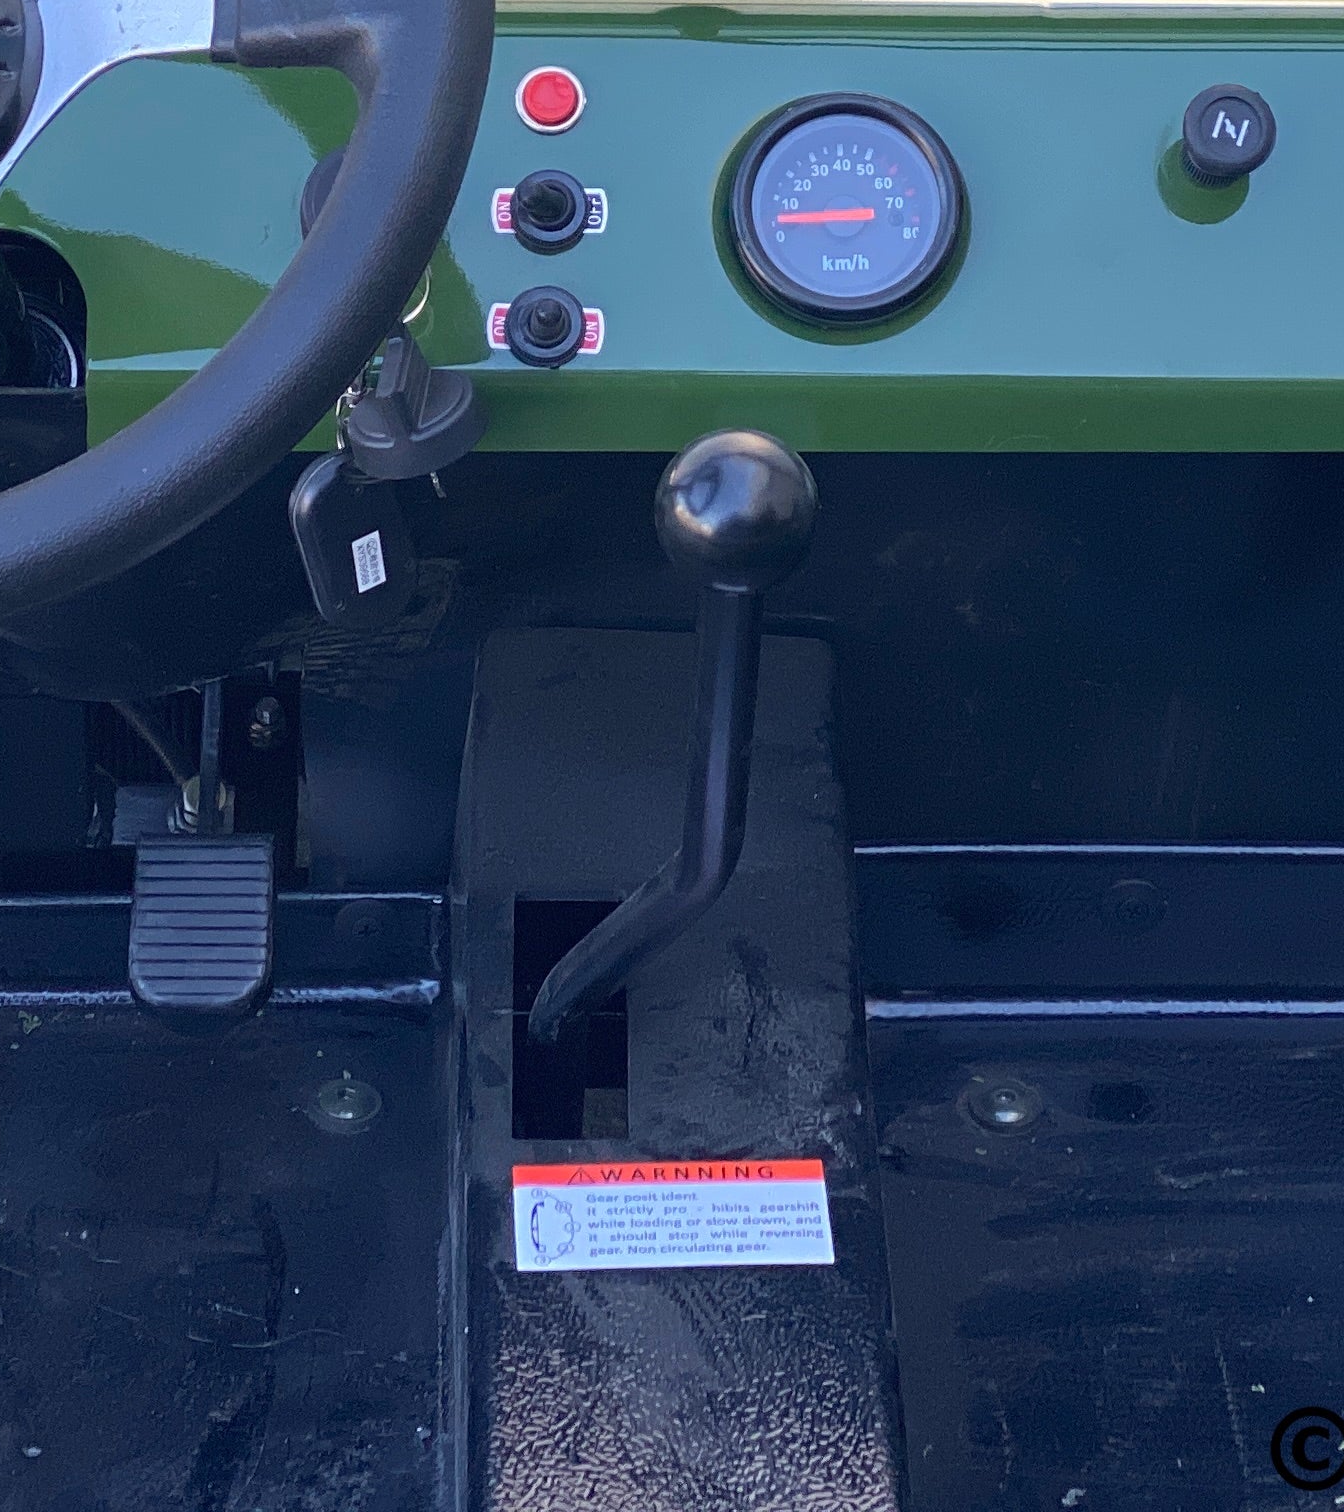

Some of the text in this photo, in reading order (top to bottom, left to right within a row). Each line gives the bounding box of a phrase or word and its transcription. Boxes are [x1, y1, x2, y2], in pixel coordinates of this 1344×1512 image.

[810, 164, 829, 176] 30
[833, 159, 851, 171] 40
[856, 163, 874, 176] 50
[794, 179, 812, 191] 20
[874, 177, 892, 189] 60
[782, 198, 799, 210] 10
[885, 196, 904, 209] 70
[498, 201, 512, 222] ON
[776, 230, 785, 242] 0
[822, 254, 870, 272] km/h
[584, 320, 598, 342] ON
[601, 1165, 775, 1185] WARNNING
[586, 1193, 619, 1203] Gear
[607, 1204, 654, 1216] strictly
[664, 1206, 687, 1216] pro
[760, 1200, 820, 1213] gearshift
[588, 1219, 626, 1229] while
[630, 1217, 682, 1228] loading
[686, 1218, 701, 1226] or
[706, 1216, 738, 1226] slow
[796, 1215, 821, 1225] and
[610, 1230, 657, 1242] should
[668, 1231, 699, 1241] stop
[710, 1228, 748, 1239] while
[760, 1228, 824, 1239] reversing
[627, 1245, 657, 1255] Non
[660, 1243, 733, 1254] circulating
